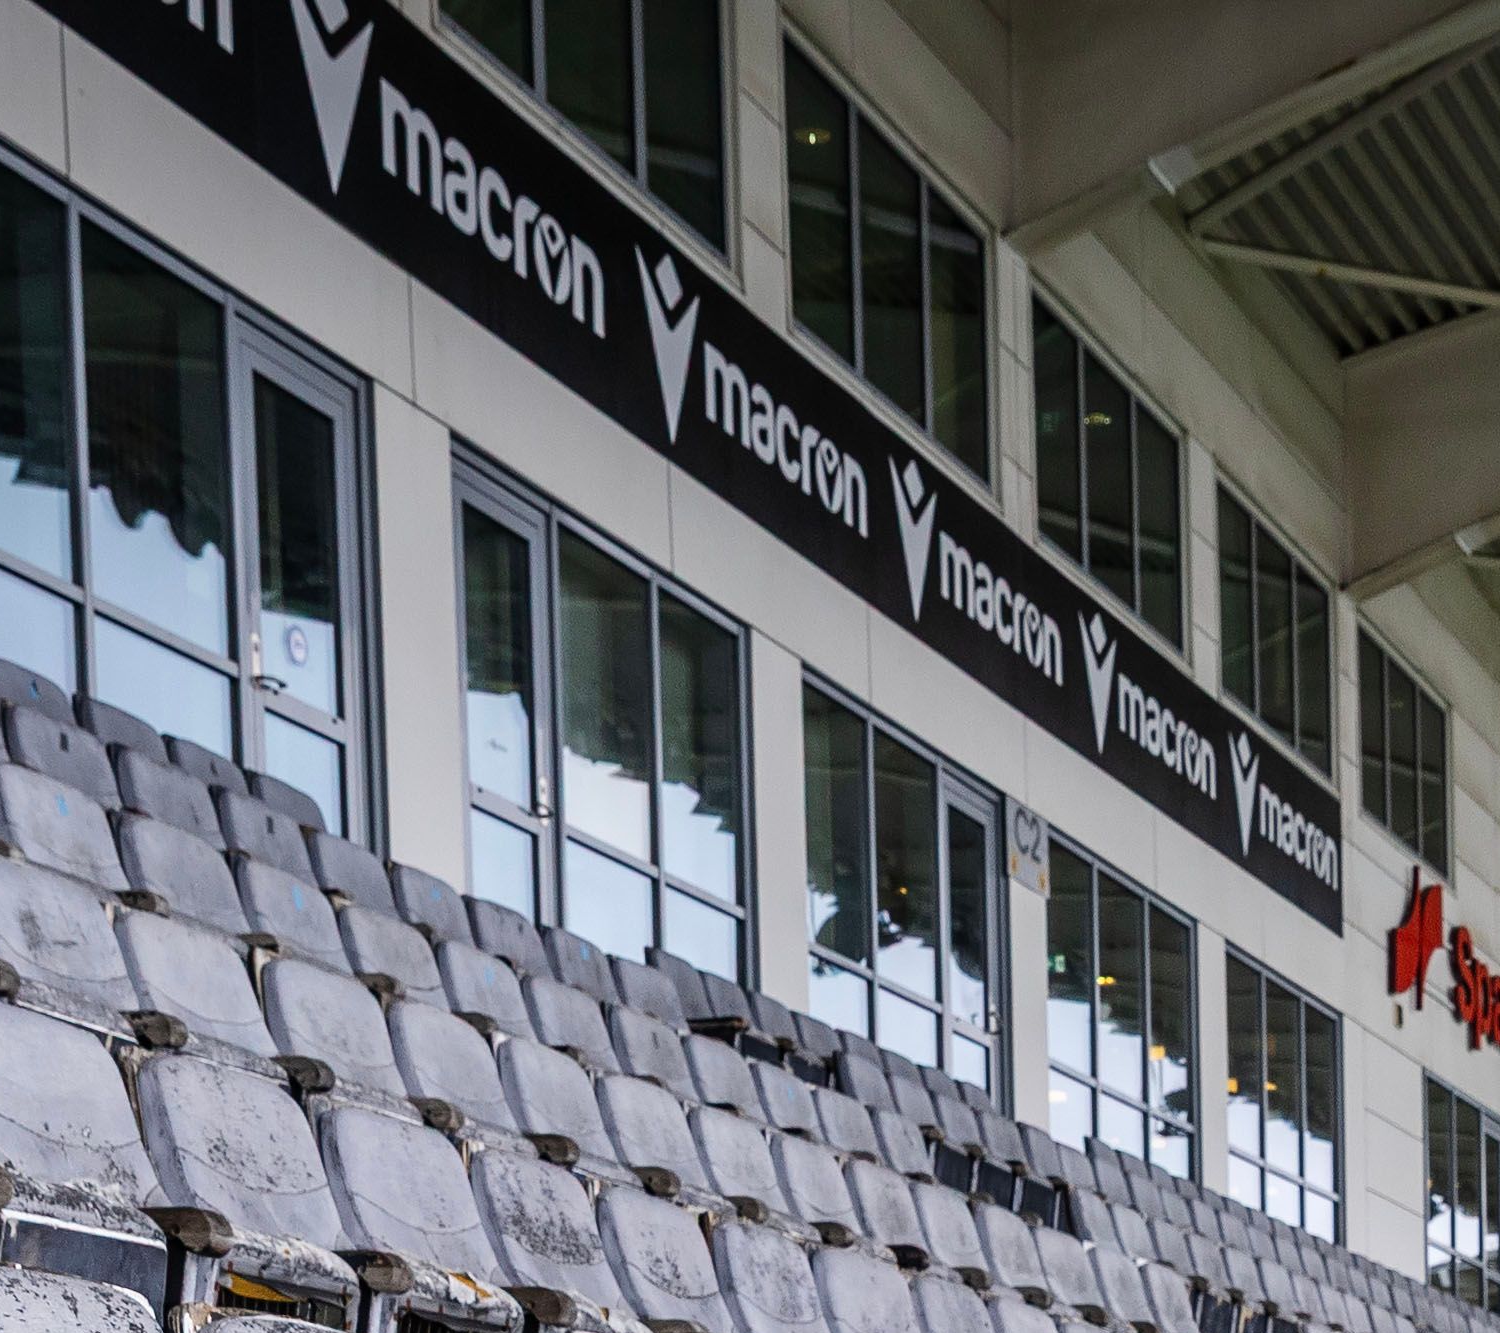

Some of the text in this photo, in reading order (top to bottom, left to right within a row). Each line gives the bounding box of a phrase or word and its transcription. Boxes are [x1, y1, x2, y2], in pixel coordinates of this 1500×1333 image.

[379, 76, 605, 339] macron
[704, 340, 868, 537] macron
[940, 530, 1063, 687] macron
[1118, 673, 1217, 800] macron
[1013, 806, 1041, 864] C2
[1259, 781, 1338, 891] macron
